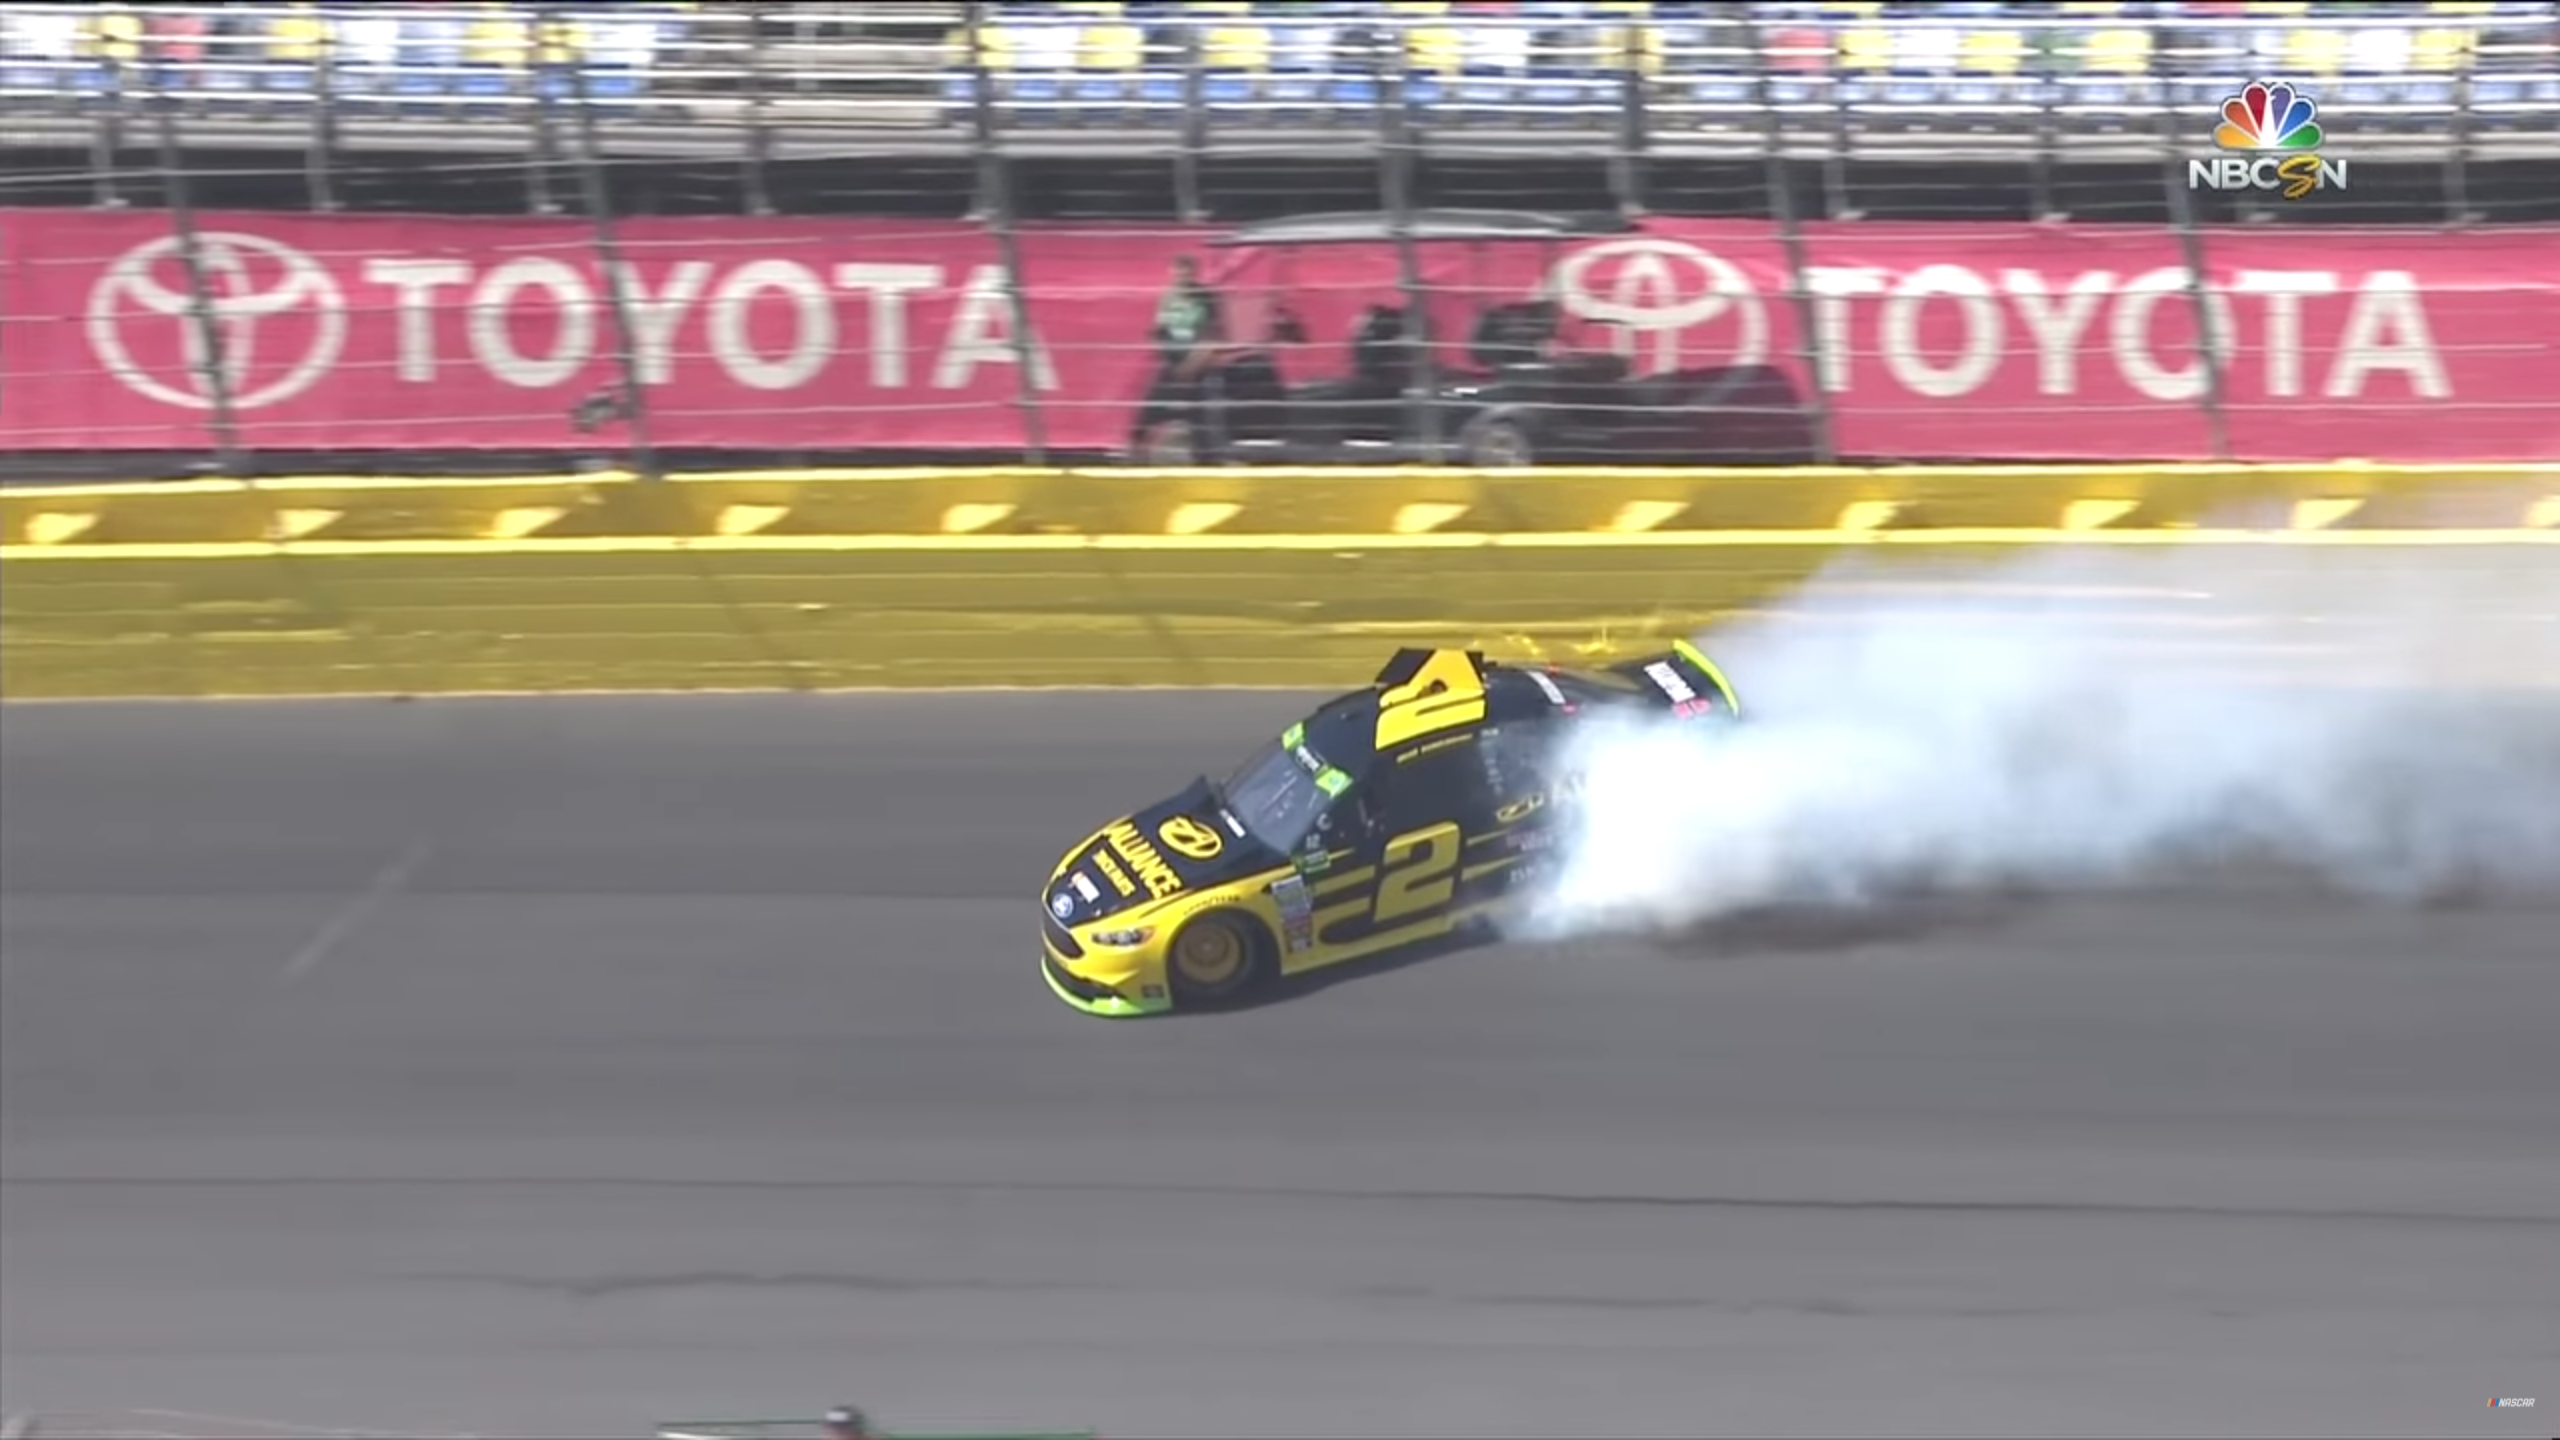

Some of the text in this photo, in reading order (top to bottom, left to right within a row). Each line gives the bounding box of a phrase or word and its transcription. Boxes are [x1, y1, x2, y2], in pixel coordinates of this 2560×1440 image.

[363, 258, 1060, 390] TOYOTA
[1801, 264, 2453, 398] TOYOTA
[1104, 822, 1184, 900] ALLIANCE
[1374, 822, 1460, 922] 2
